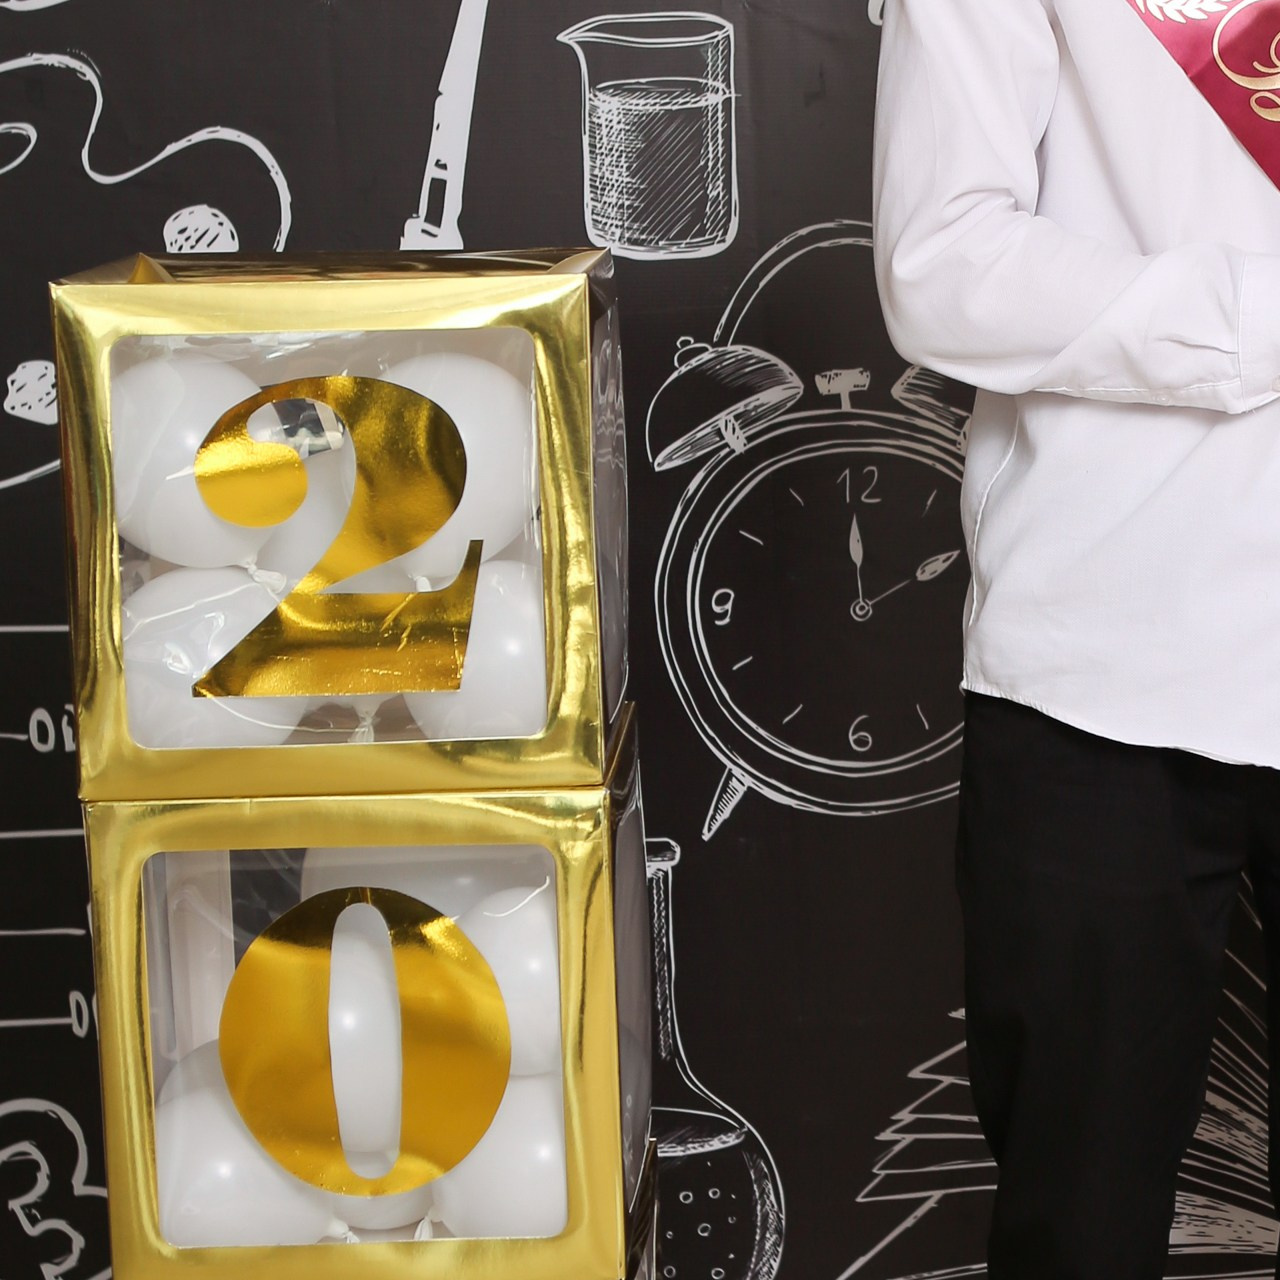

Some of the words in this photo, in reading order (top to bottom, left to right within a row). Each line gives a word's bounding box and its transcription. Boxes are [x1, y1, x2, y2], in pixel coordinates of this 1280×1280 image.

[836, 466, 882, 504] 12
[711, 588, 735, 626] 9
[848, 715, 873, 751] 6
